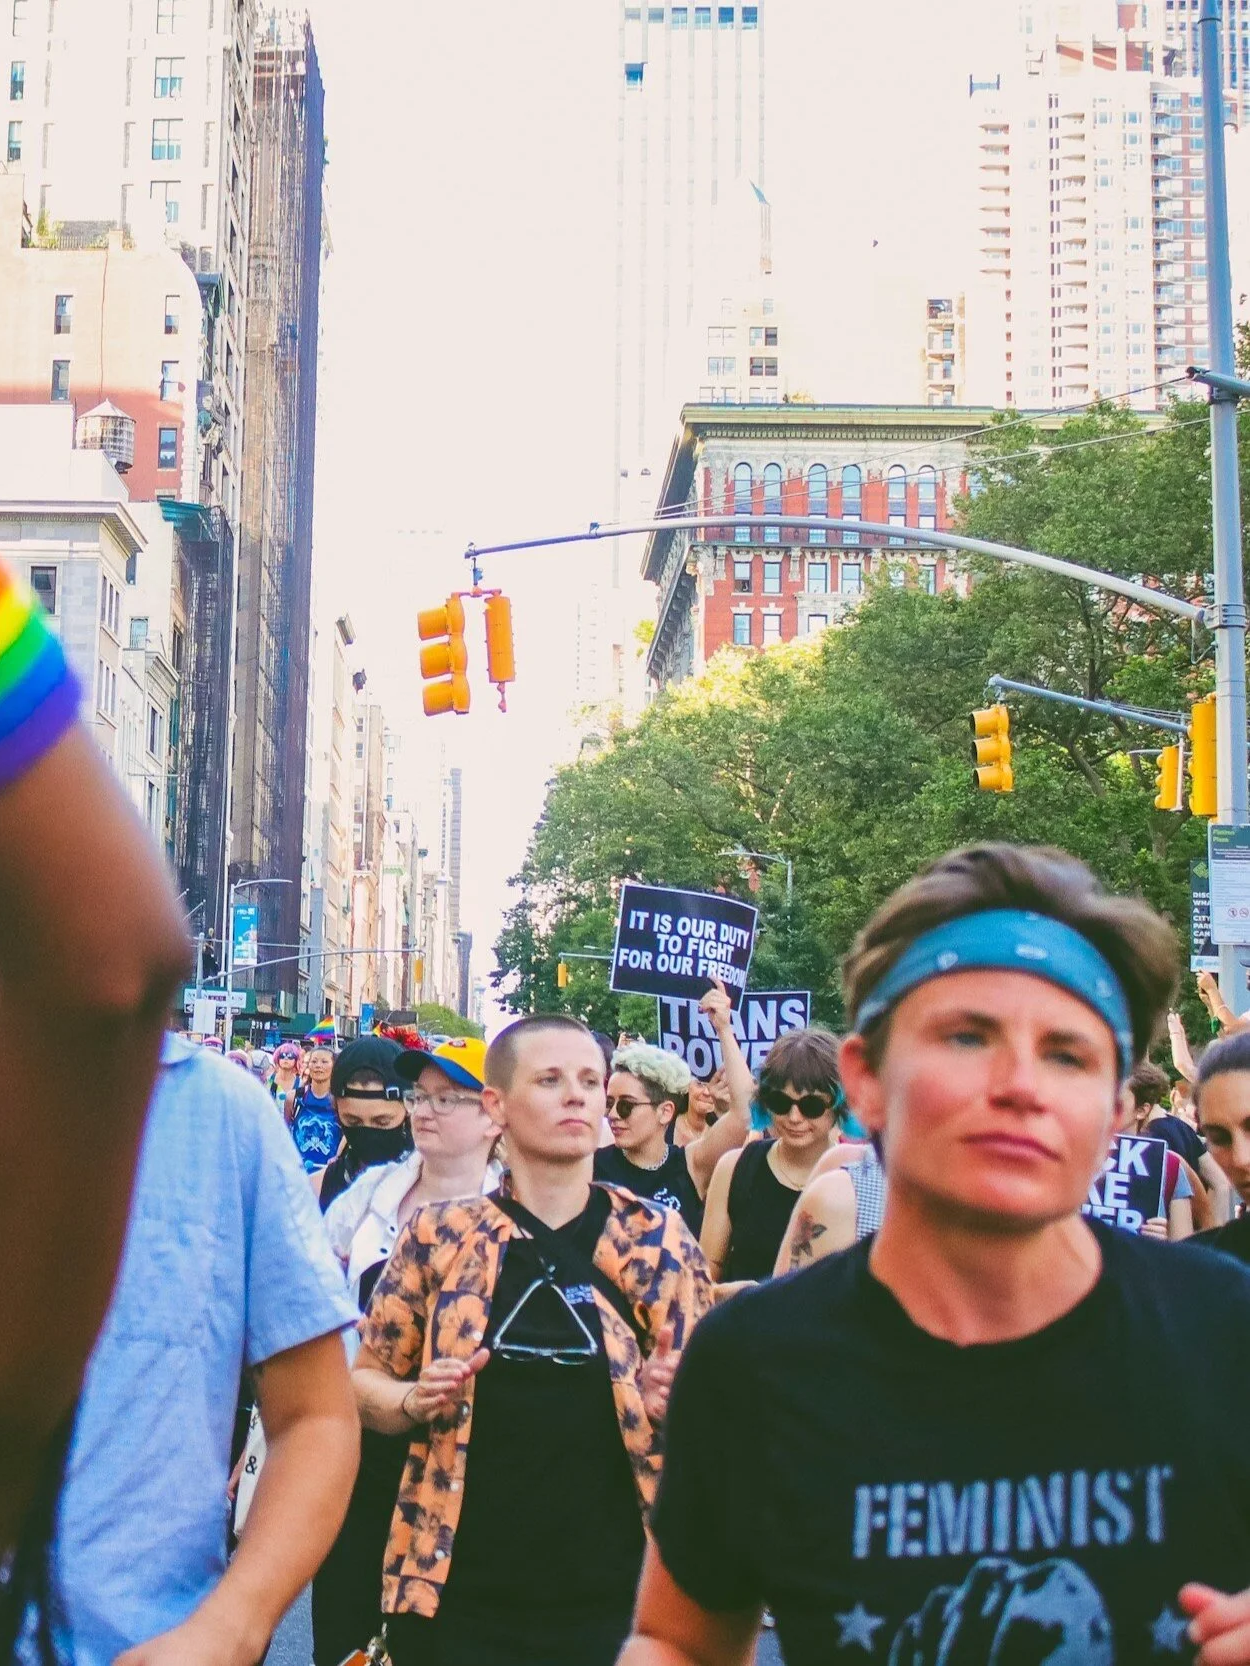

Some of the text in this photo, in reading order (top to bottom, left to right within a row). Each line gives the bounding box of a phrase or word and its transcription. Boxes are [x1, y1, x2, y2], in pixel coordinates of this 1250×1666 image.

[629, 910, 750, 950] IT IS OUR DUTY
[656, 934, 735, 964] TO FIGHT
[618, 948, 747, 988] FOR OUR FREEDOM
[245, 1455, 257, 1475] &
[852, 1464, 1174, 1559] FEMINIST
